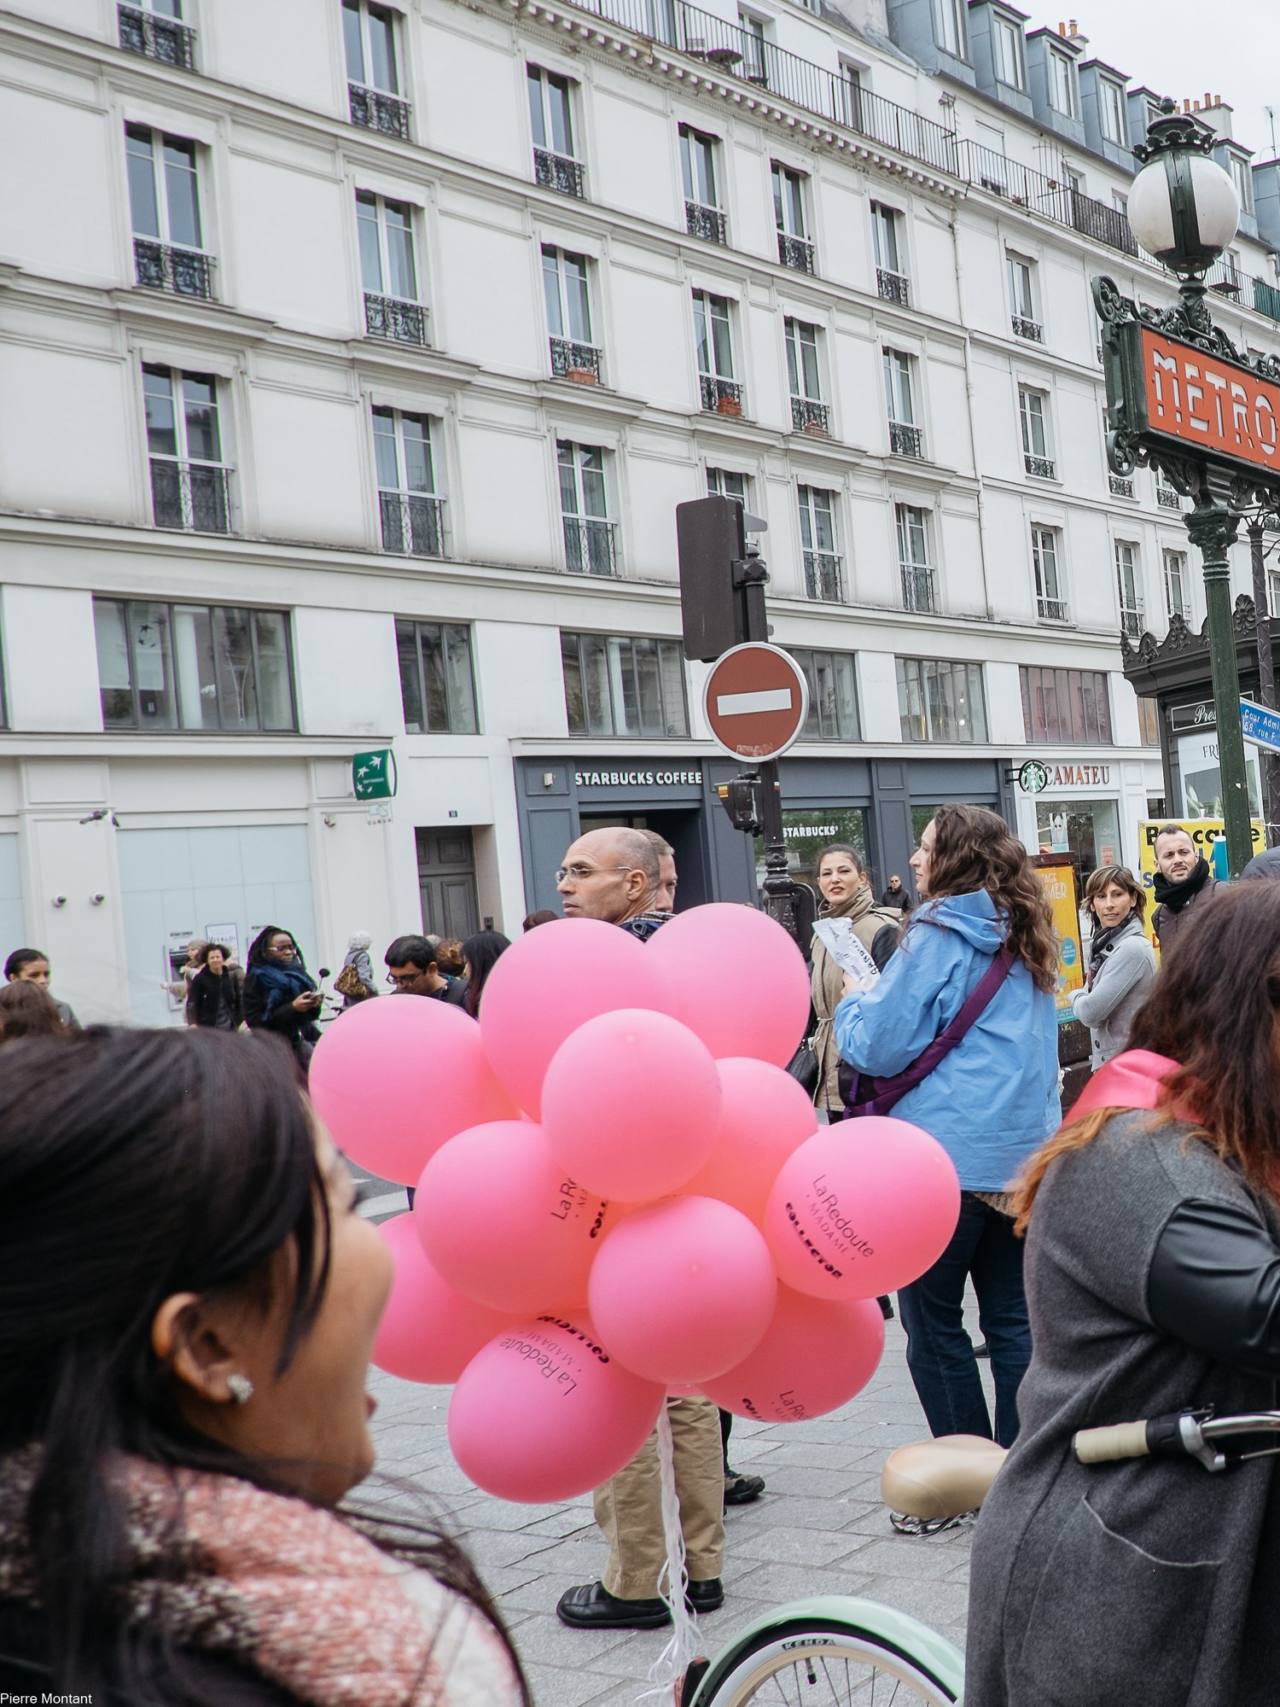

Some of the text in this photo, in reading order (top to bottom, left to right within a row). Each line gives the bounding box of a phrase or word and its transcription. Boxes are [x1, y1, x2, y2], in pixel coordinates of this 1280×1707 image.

[1153, 349, 1277, 455] METRO
[1194, 705, 1218, 724] Pres
[1244, 708, 1261, 725] Cour
[575, 771, 703, 786] STARBUCKS COFFEE
[550, 1200, 572, 1220] La
[813, 1174, 875, 1258] La Redoute
[500, 1337, 577, 1397] La Redoute
